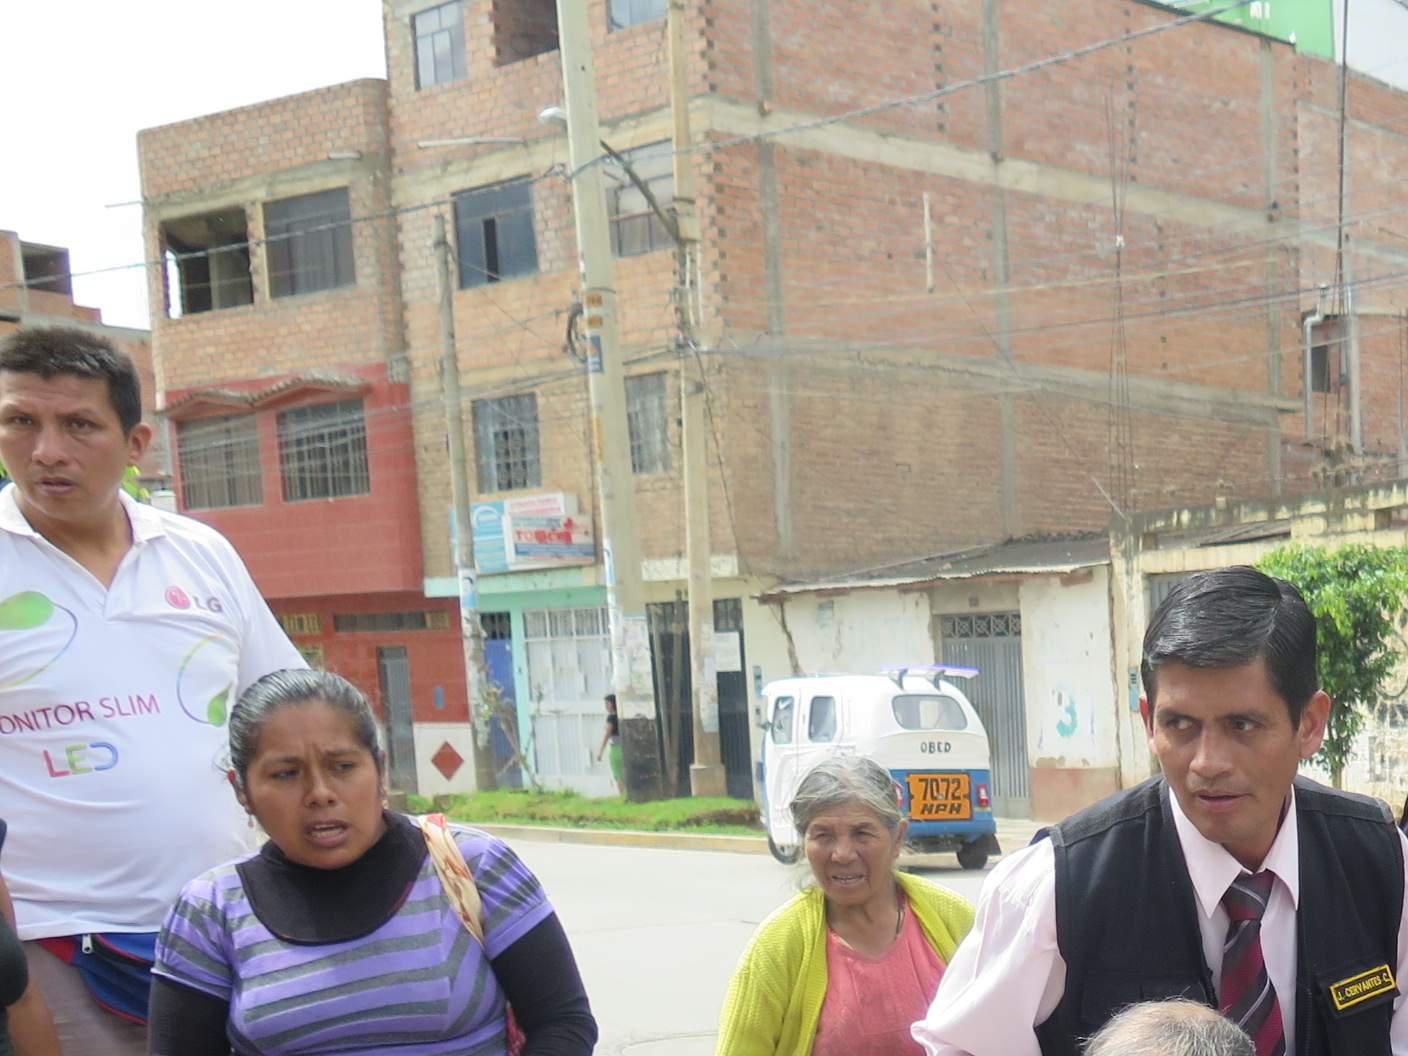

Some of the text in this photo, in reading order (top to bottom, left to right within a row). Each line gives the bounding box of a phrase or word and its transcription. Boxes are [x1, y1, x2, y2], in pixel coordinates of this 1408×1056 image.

[192, 595, 223, 613] LG
[97, 693, 160, 719] SLIM
[43, 741, 119, 777] LED
[918, 777, 961, 801] 7072
